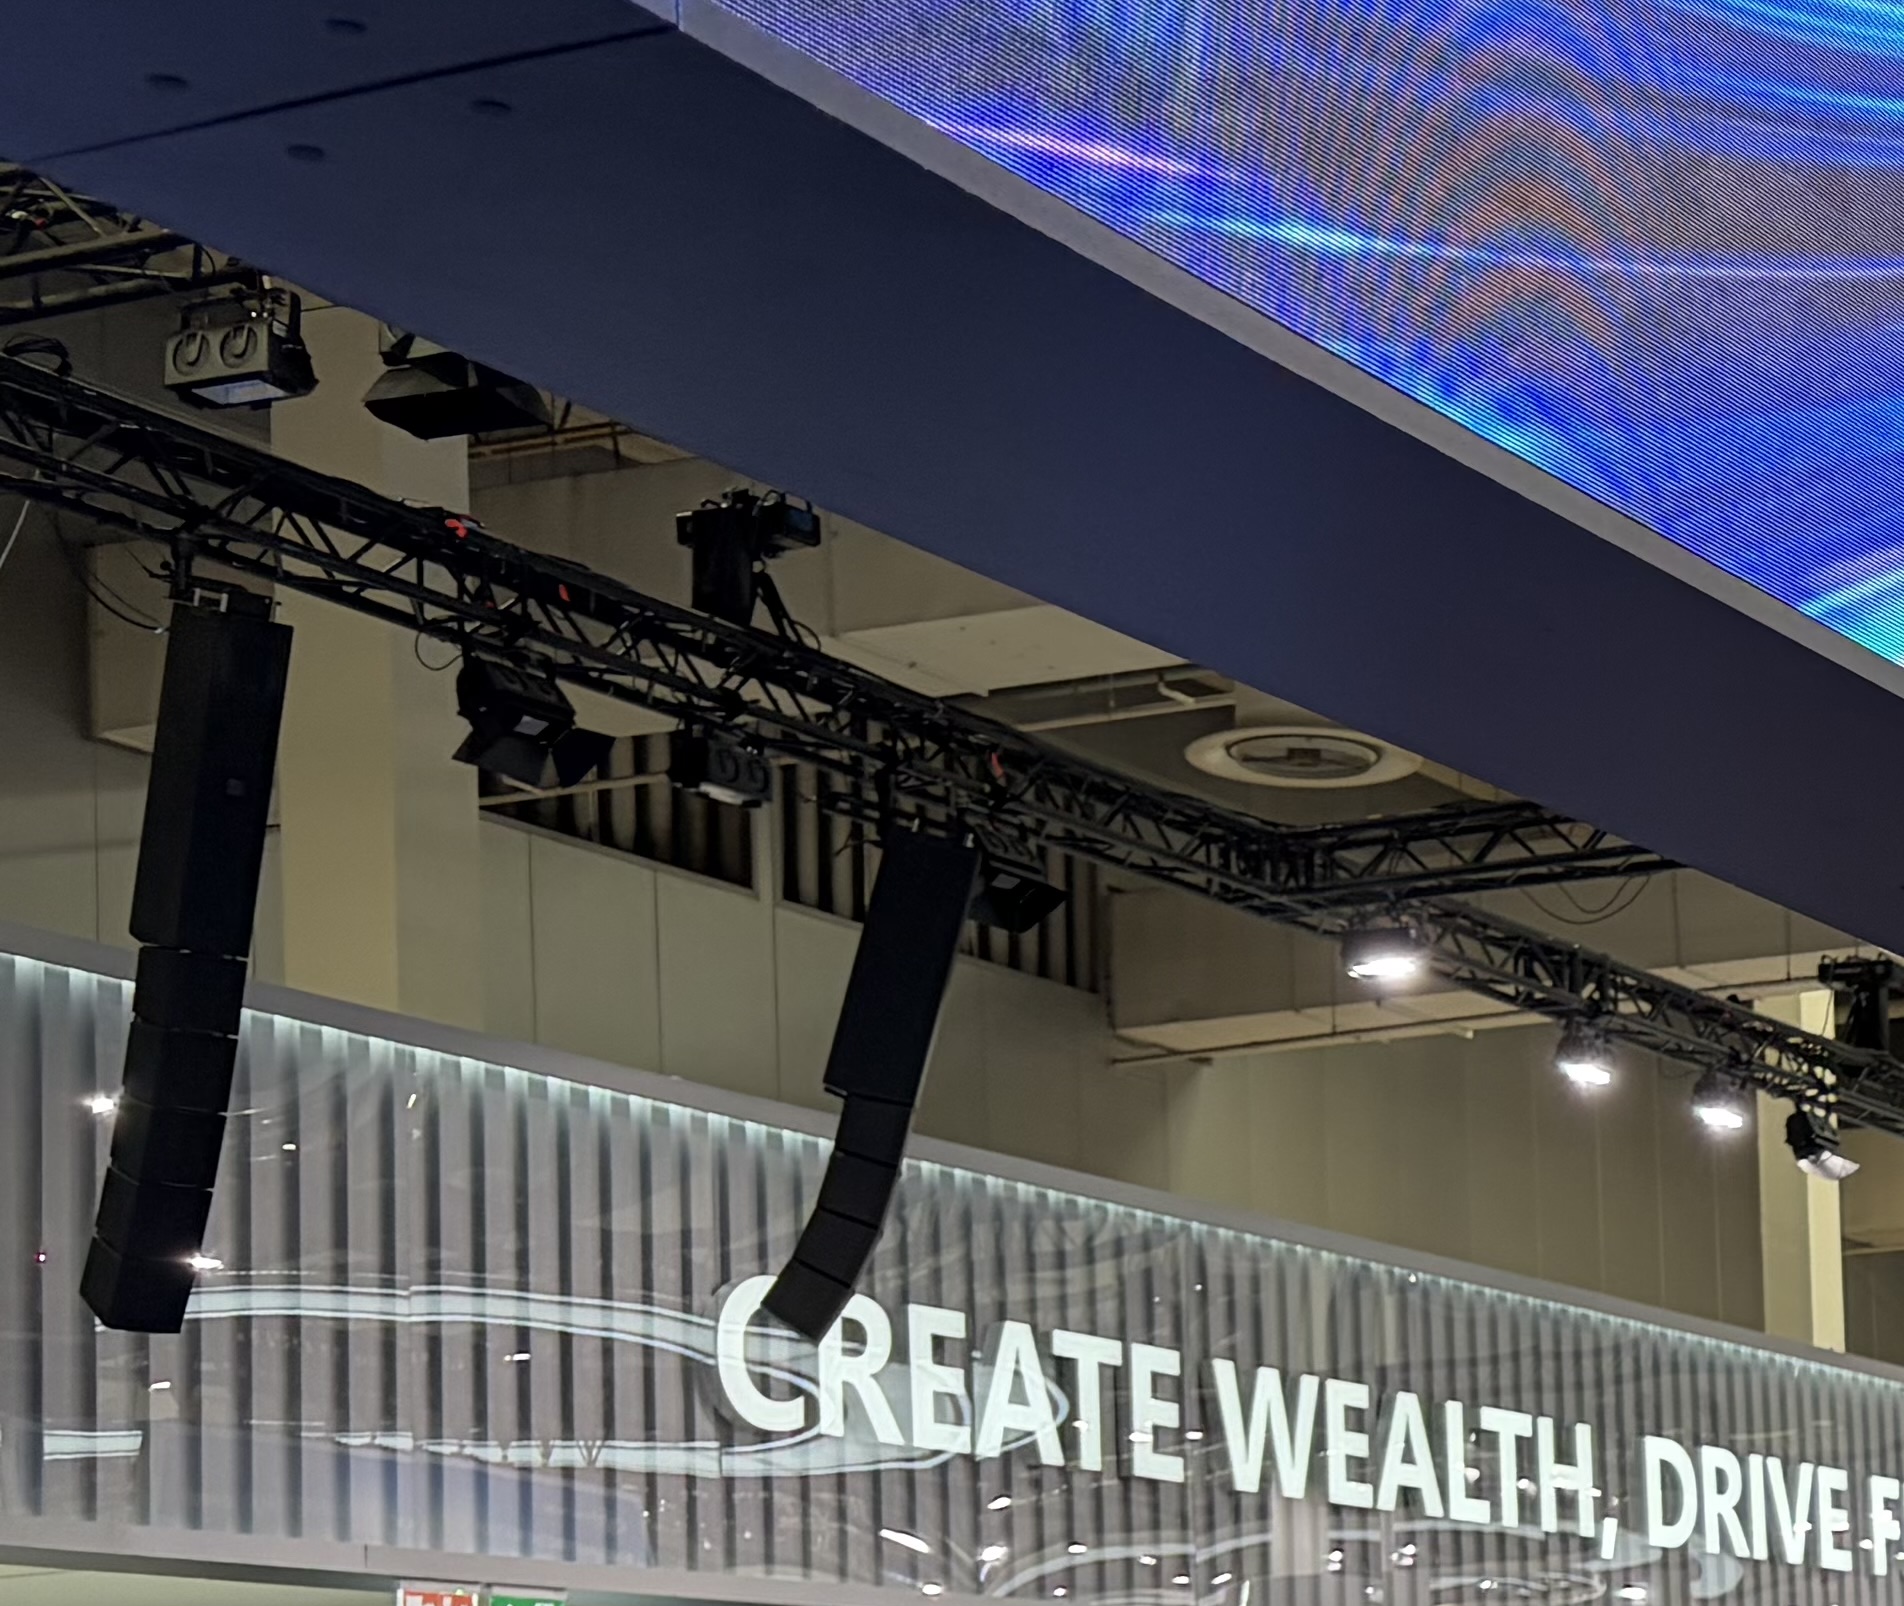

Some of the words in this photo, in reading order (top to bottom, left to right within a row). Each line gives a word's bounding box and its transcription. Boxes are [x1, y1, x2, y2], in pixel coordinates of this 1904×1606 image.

[717, 1274, 1185, 1482] CREATE
[1212, 1358, 1619, 1560] WEALTH,
[1643, 1435, 1853, 1572] DRIVE
